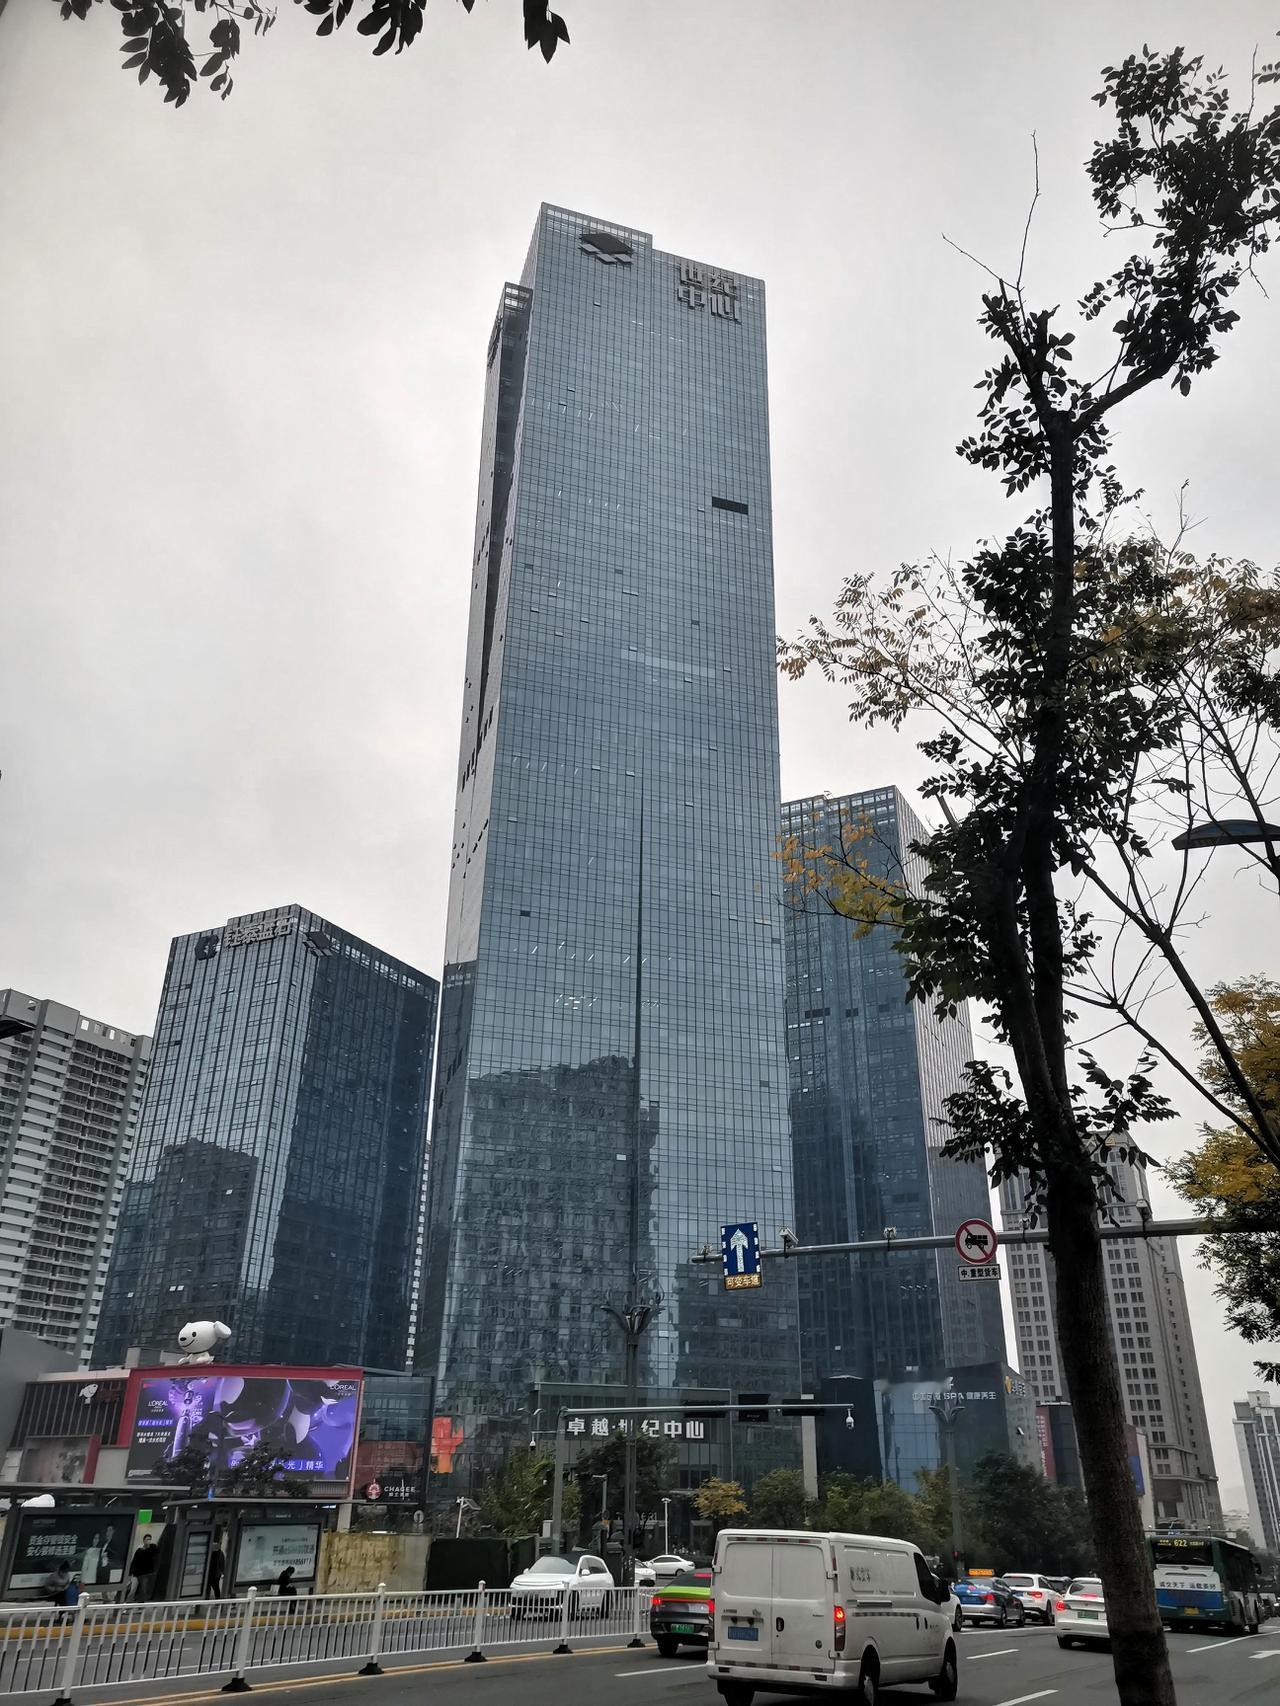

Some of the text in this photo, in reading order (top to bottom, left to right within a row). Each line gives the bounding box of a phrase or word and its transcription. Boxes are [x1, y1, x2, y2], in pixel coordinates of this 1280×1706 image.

[679, 262, 737, 298] 世纪
[677, 286, 742, 324] 中心
[1173, 1539, 1188, 1547] 622
